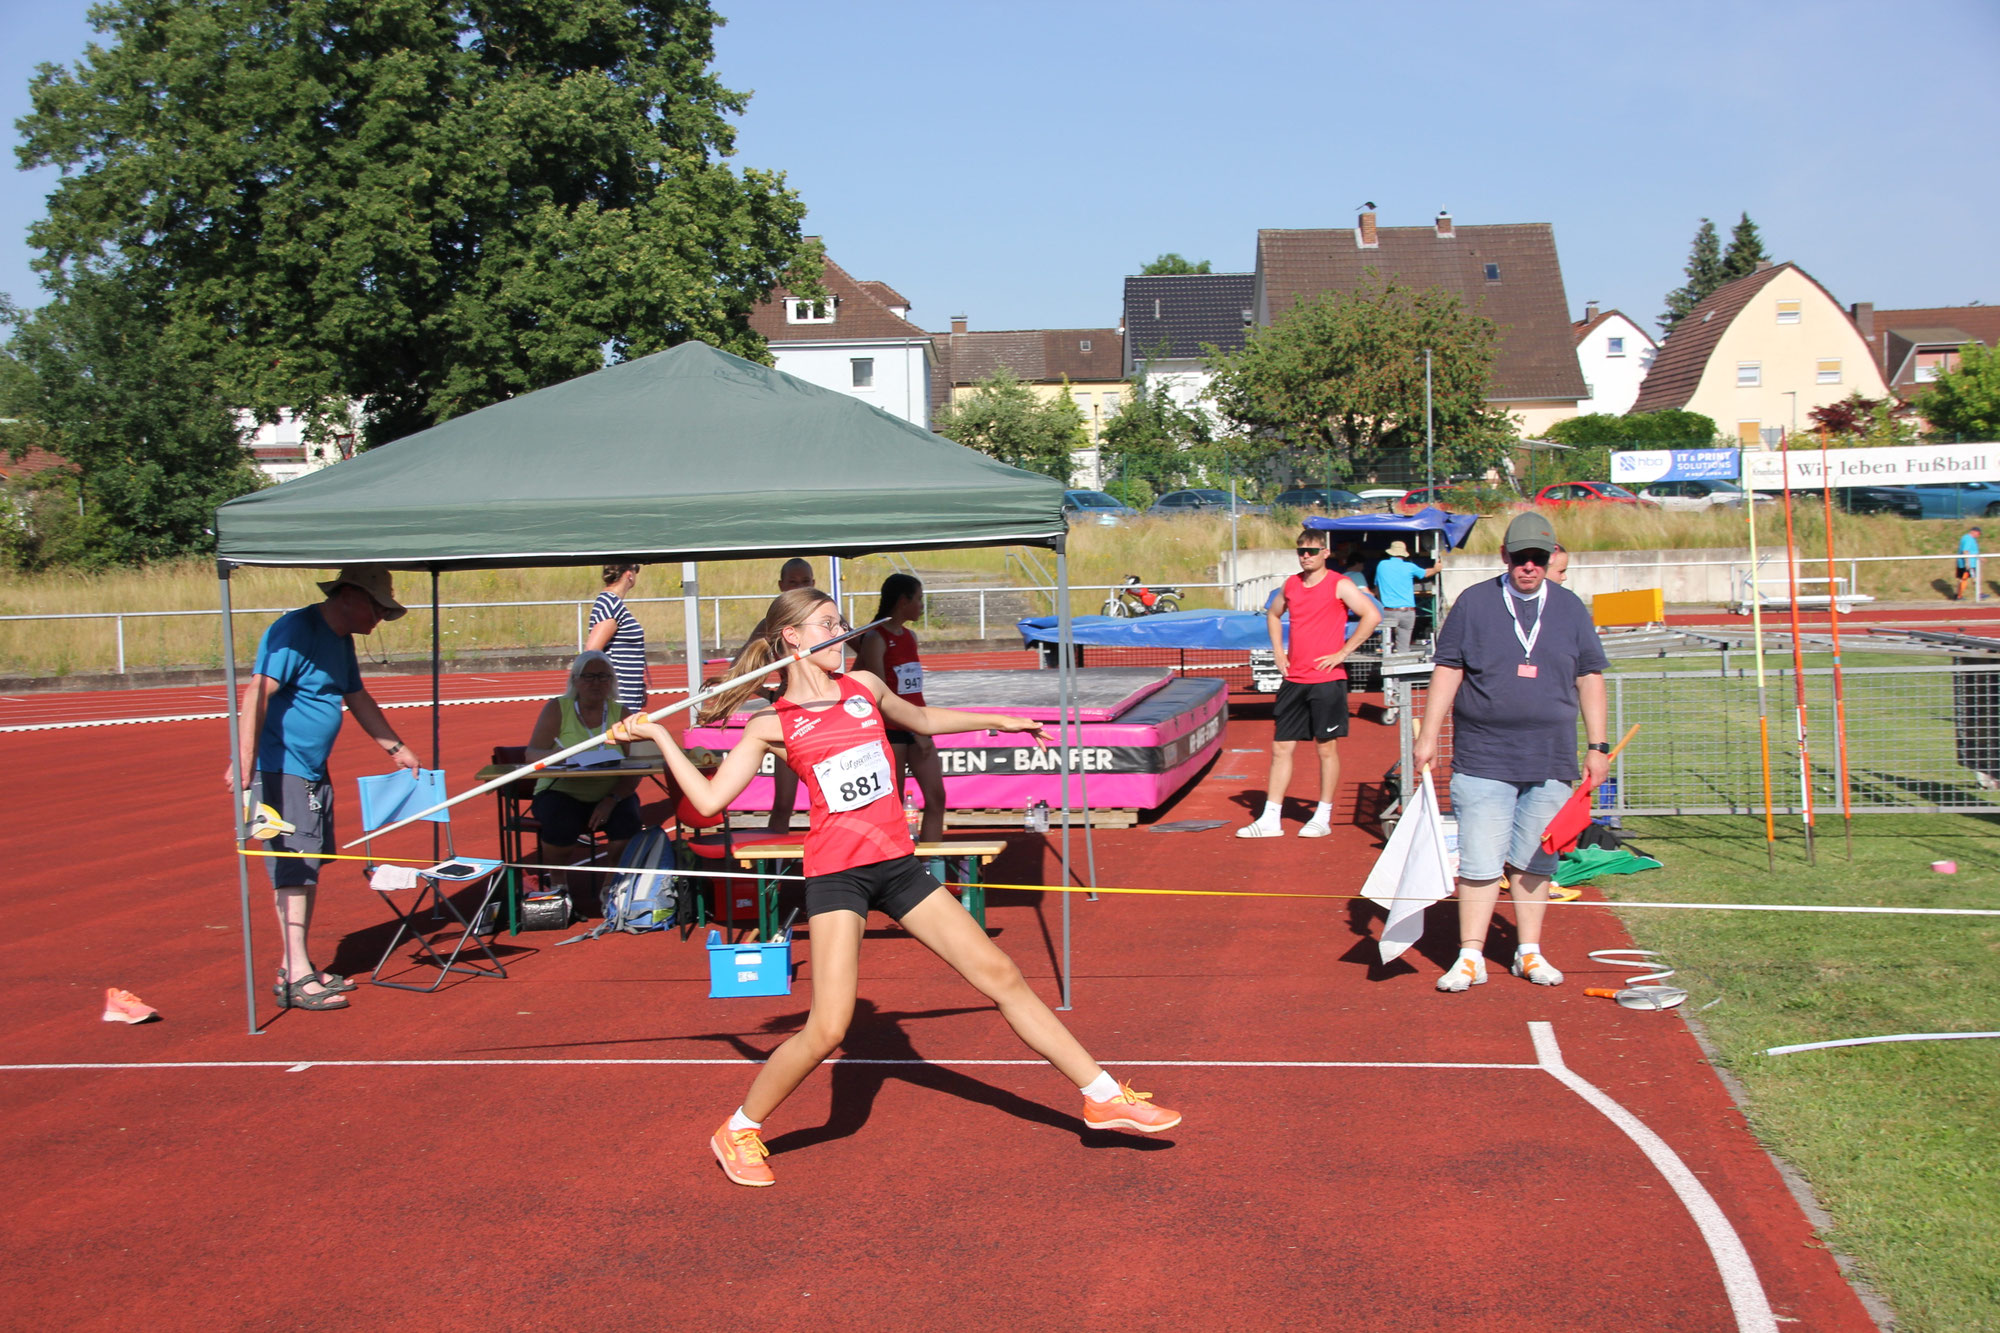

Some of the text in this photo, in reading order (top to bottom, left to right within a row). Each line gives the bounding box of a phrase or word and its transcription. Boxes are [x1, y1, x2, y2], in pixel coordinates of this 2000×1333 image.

[1677, 453, 1689, 462] IT
[1697, 451, 1732, 461] PRINT
[1677, 461, 1732, 471] SOLUTIONS
[1840, 460, 1897, 475] leben
[1906, 456, 1986, 472] Fußball
[1014, 746, 1113, 771] BÄNFER
[840, 771, 881, 802] 881
